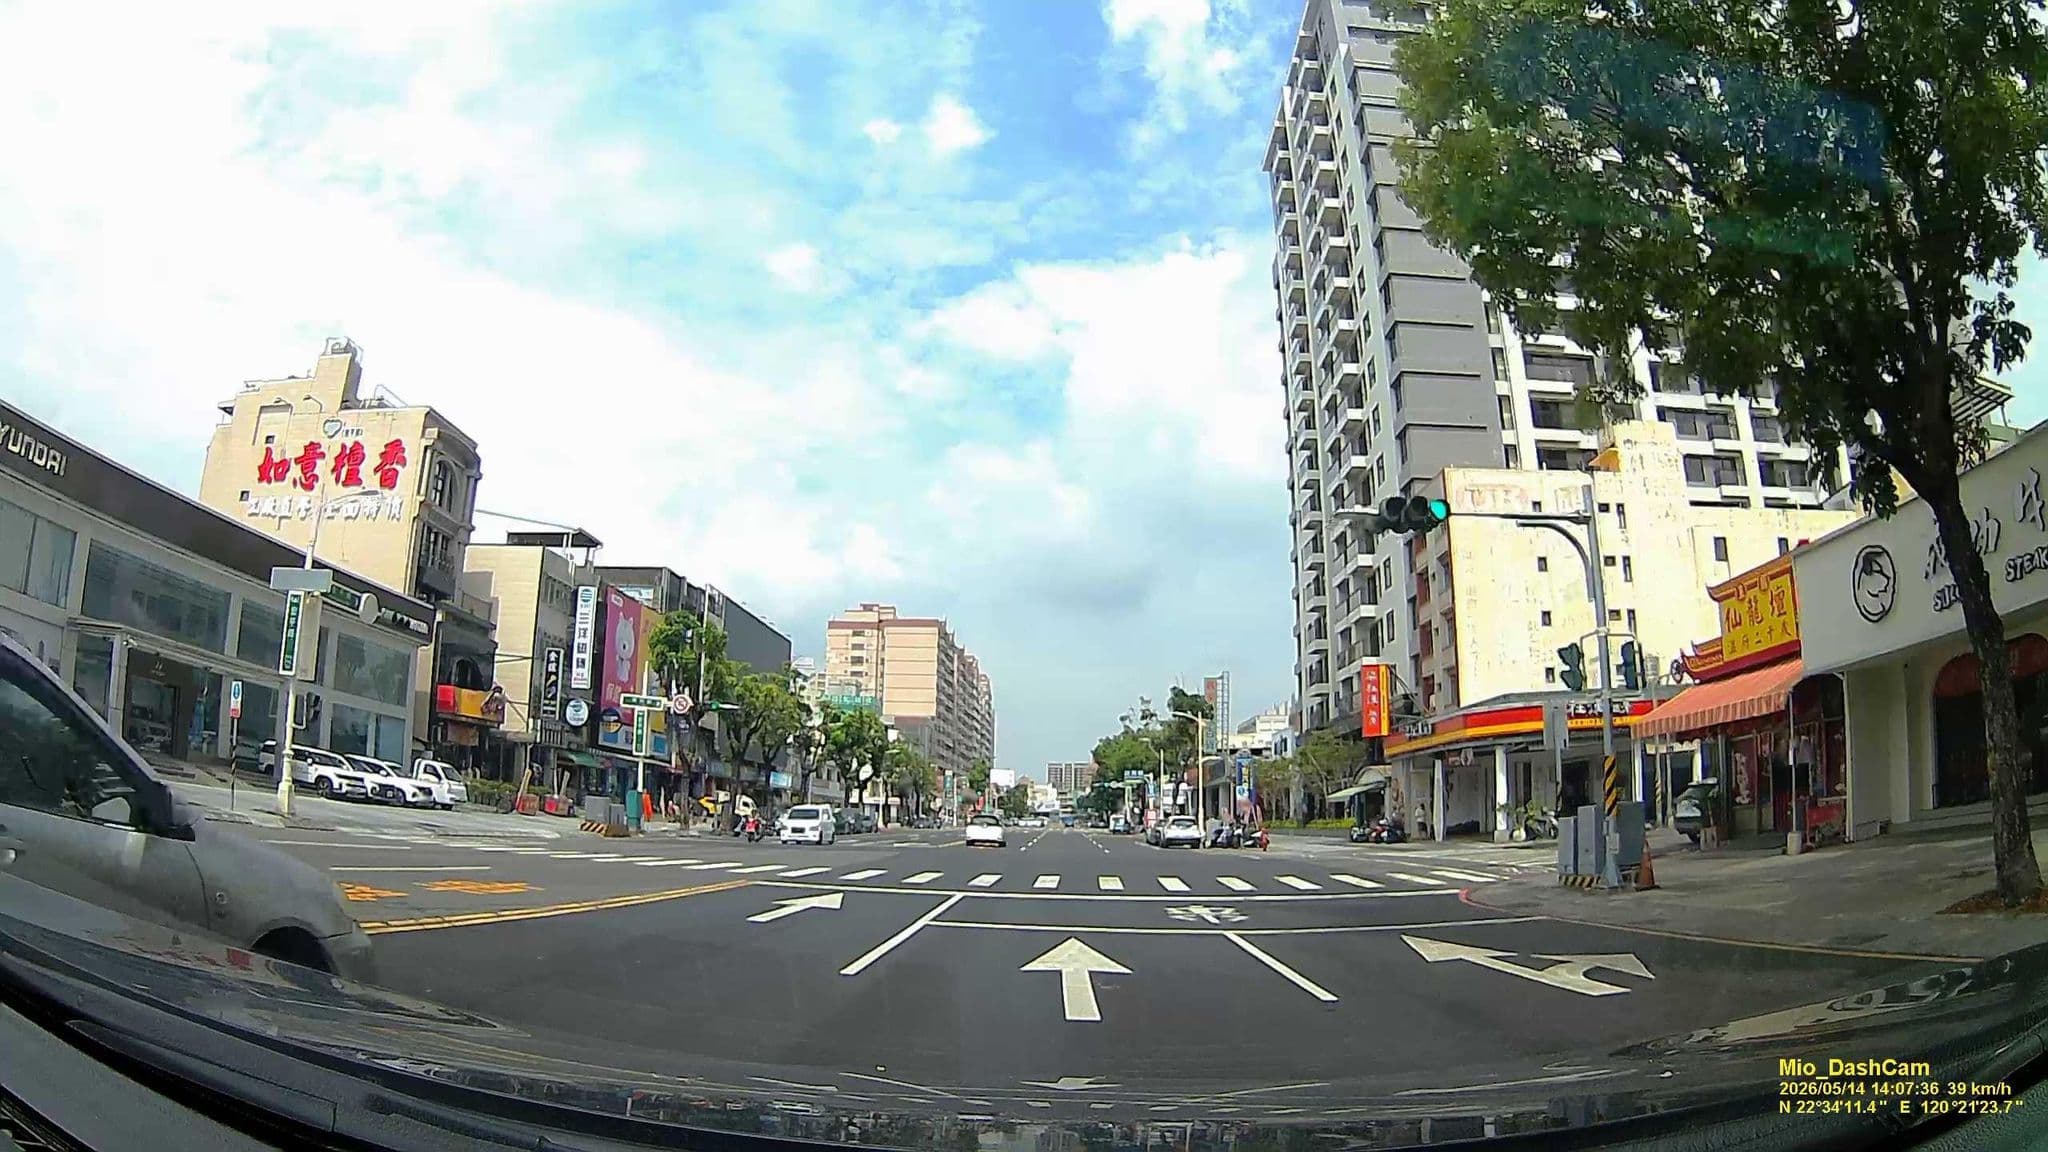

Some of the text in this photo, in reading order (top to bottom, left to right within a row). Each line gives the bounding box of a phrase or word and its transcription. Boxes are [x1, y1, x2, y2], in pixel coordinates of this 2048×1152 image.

[257, 438, 407, 492] 如意檀香
[1725, 586, 1786, 634] 仙龍壇
